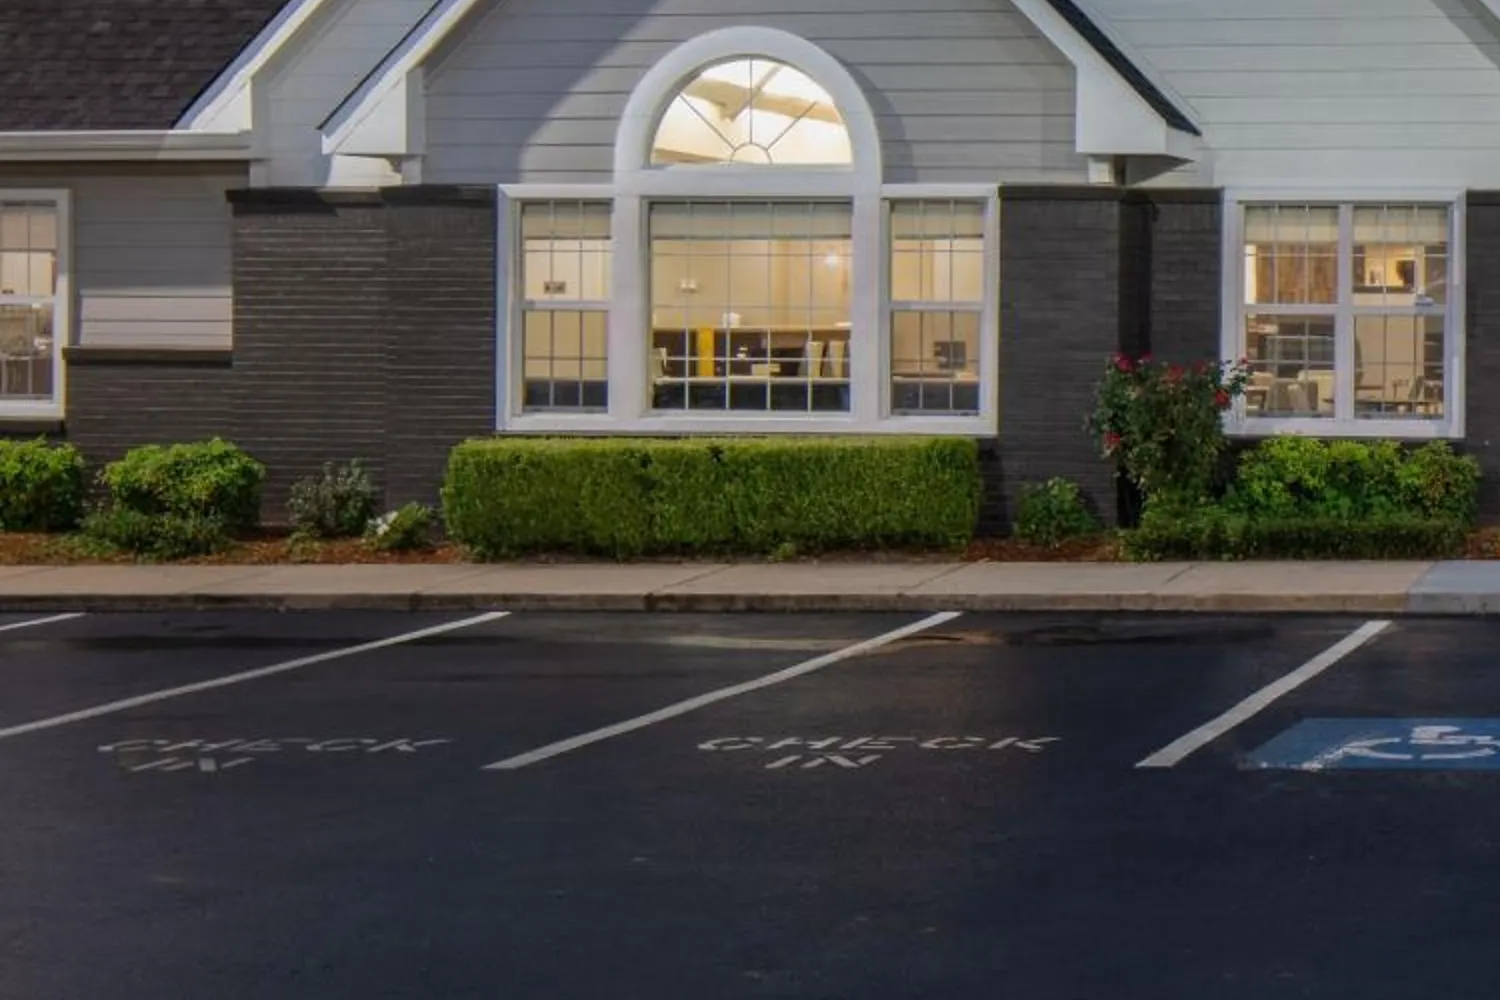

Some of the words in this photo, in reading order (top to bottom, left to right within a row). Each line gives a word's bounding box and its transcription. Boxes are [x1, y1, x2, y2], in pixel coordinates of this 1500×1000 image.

[97, 738, 453, 752] CHECK
[697, 735, 1062, 751] CHECK
[764, 754, 884, 769] IN
